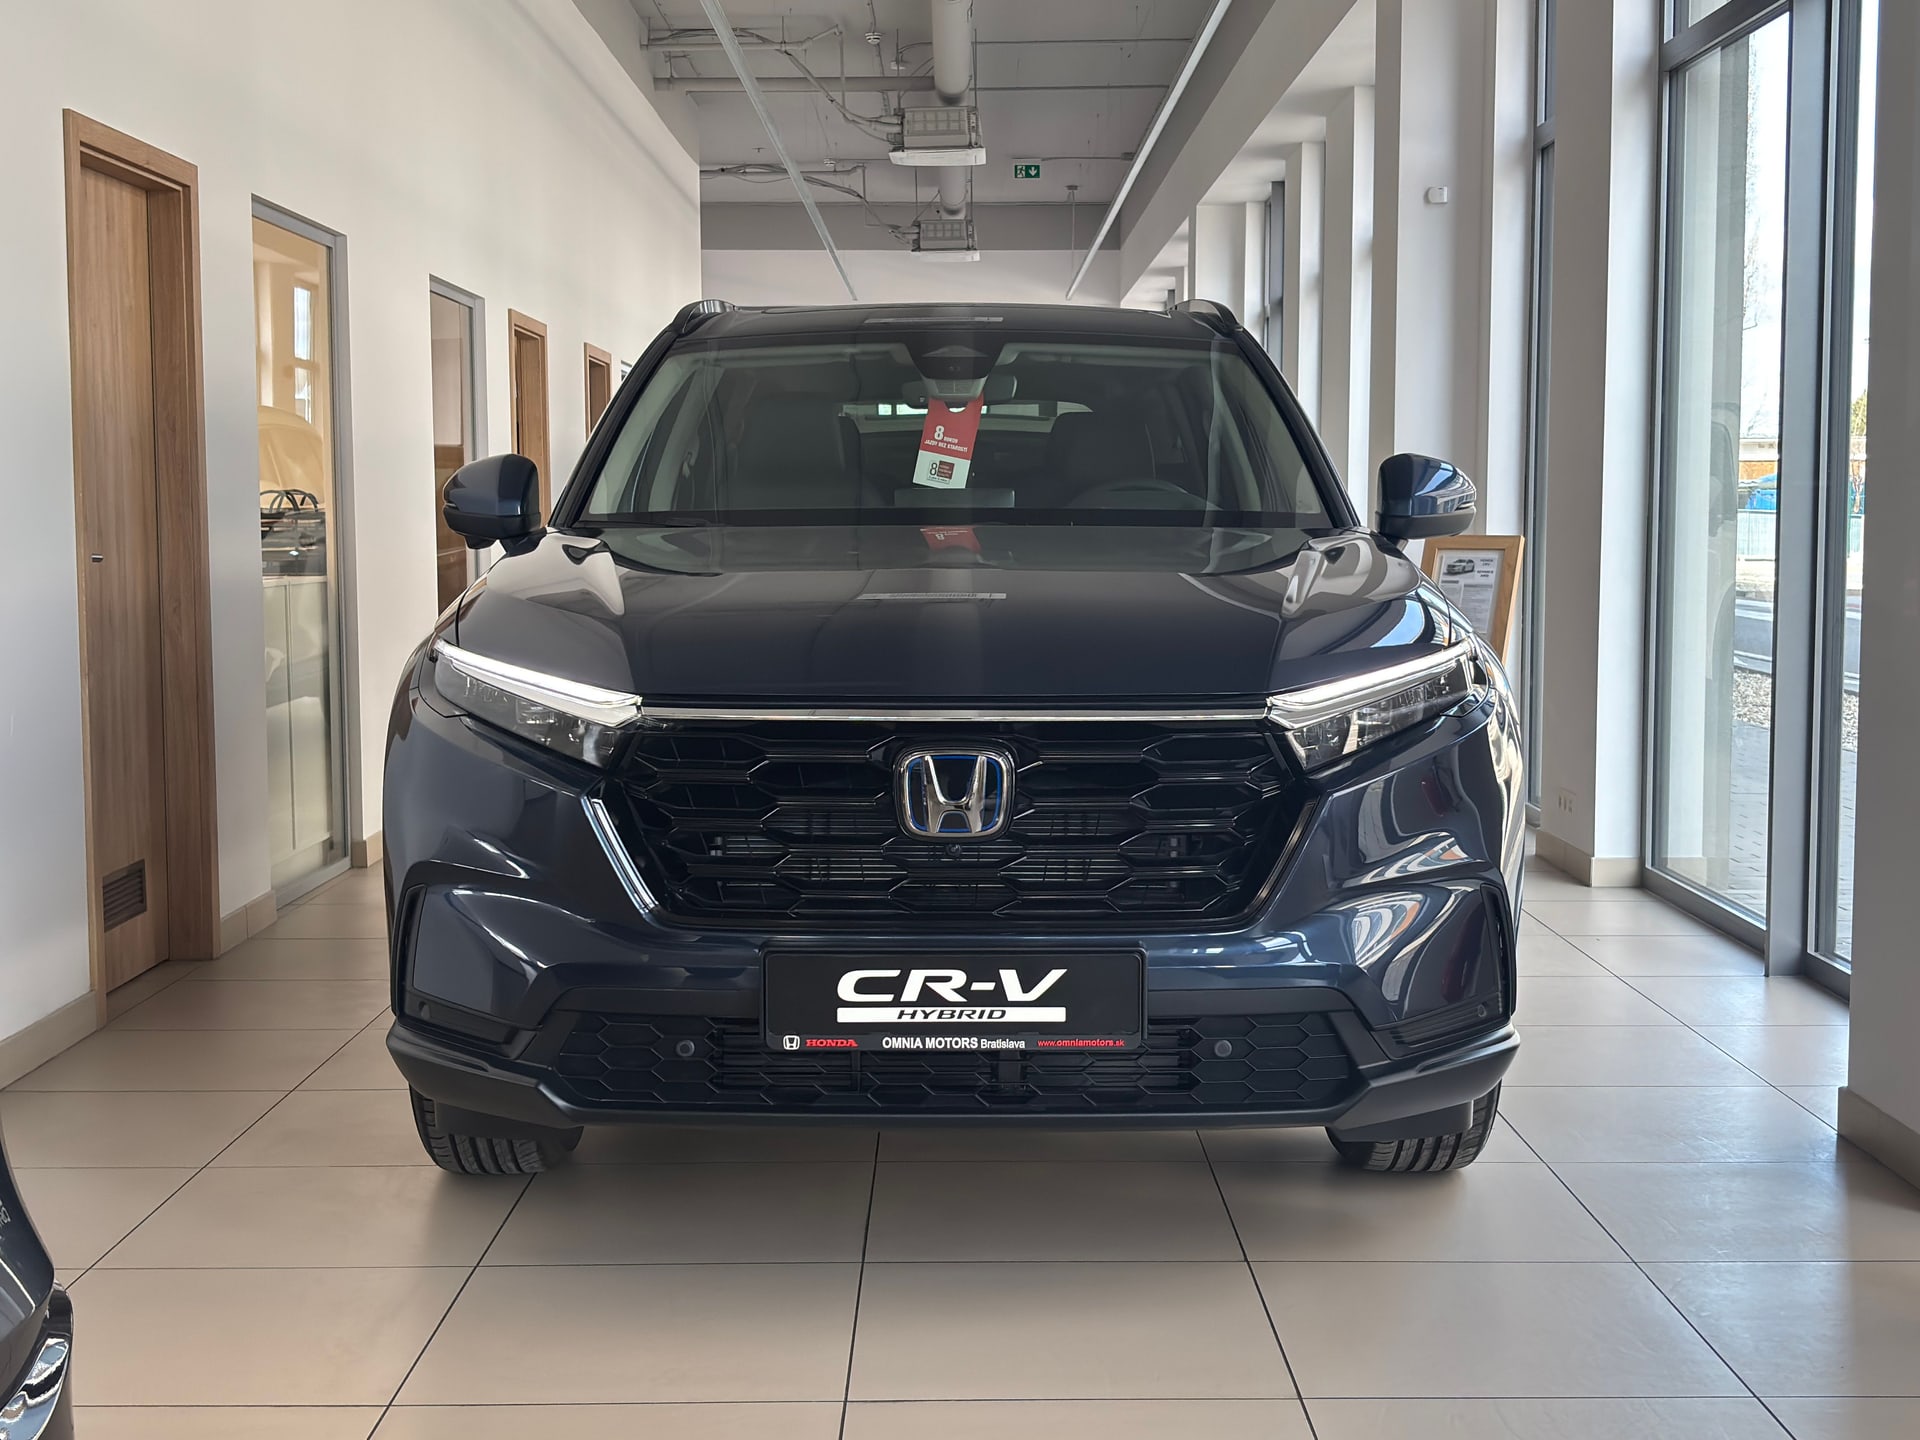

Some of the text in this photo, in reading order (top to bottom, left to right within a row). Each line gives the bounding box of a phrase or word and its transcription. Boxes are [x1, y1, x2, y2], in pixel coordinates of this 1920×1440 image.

[934, 425, 944, 440] 8
[930, 462, 938, 476] 8
[836, 968, 1068, 1002] CR-V
[896, 1009, 1007, 1020] HYBRID
[806, 1039, 858, 1047] HONDA
[882, 1037, 923, 1049] OMNIA
[925, 1037, 978, 1049] MOTORS
[980, 1038, 1026, 1049] Bratislava
[1037, 1038, 1125, 1047] www.omniamotors.sk
